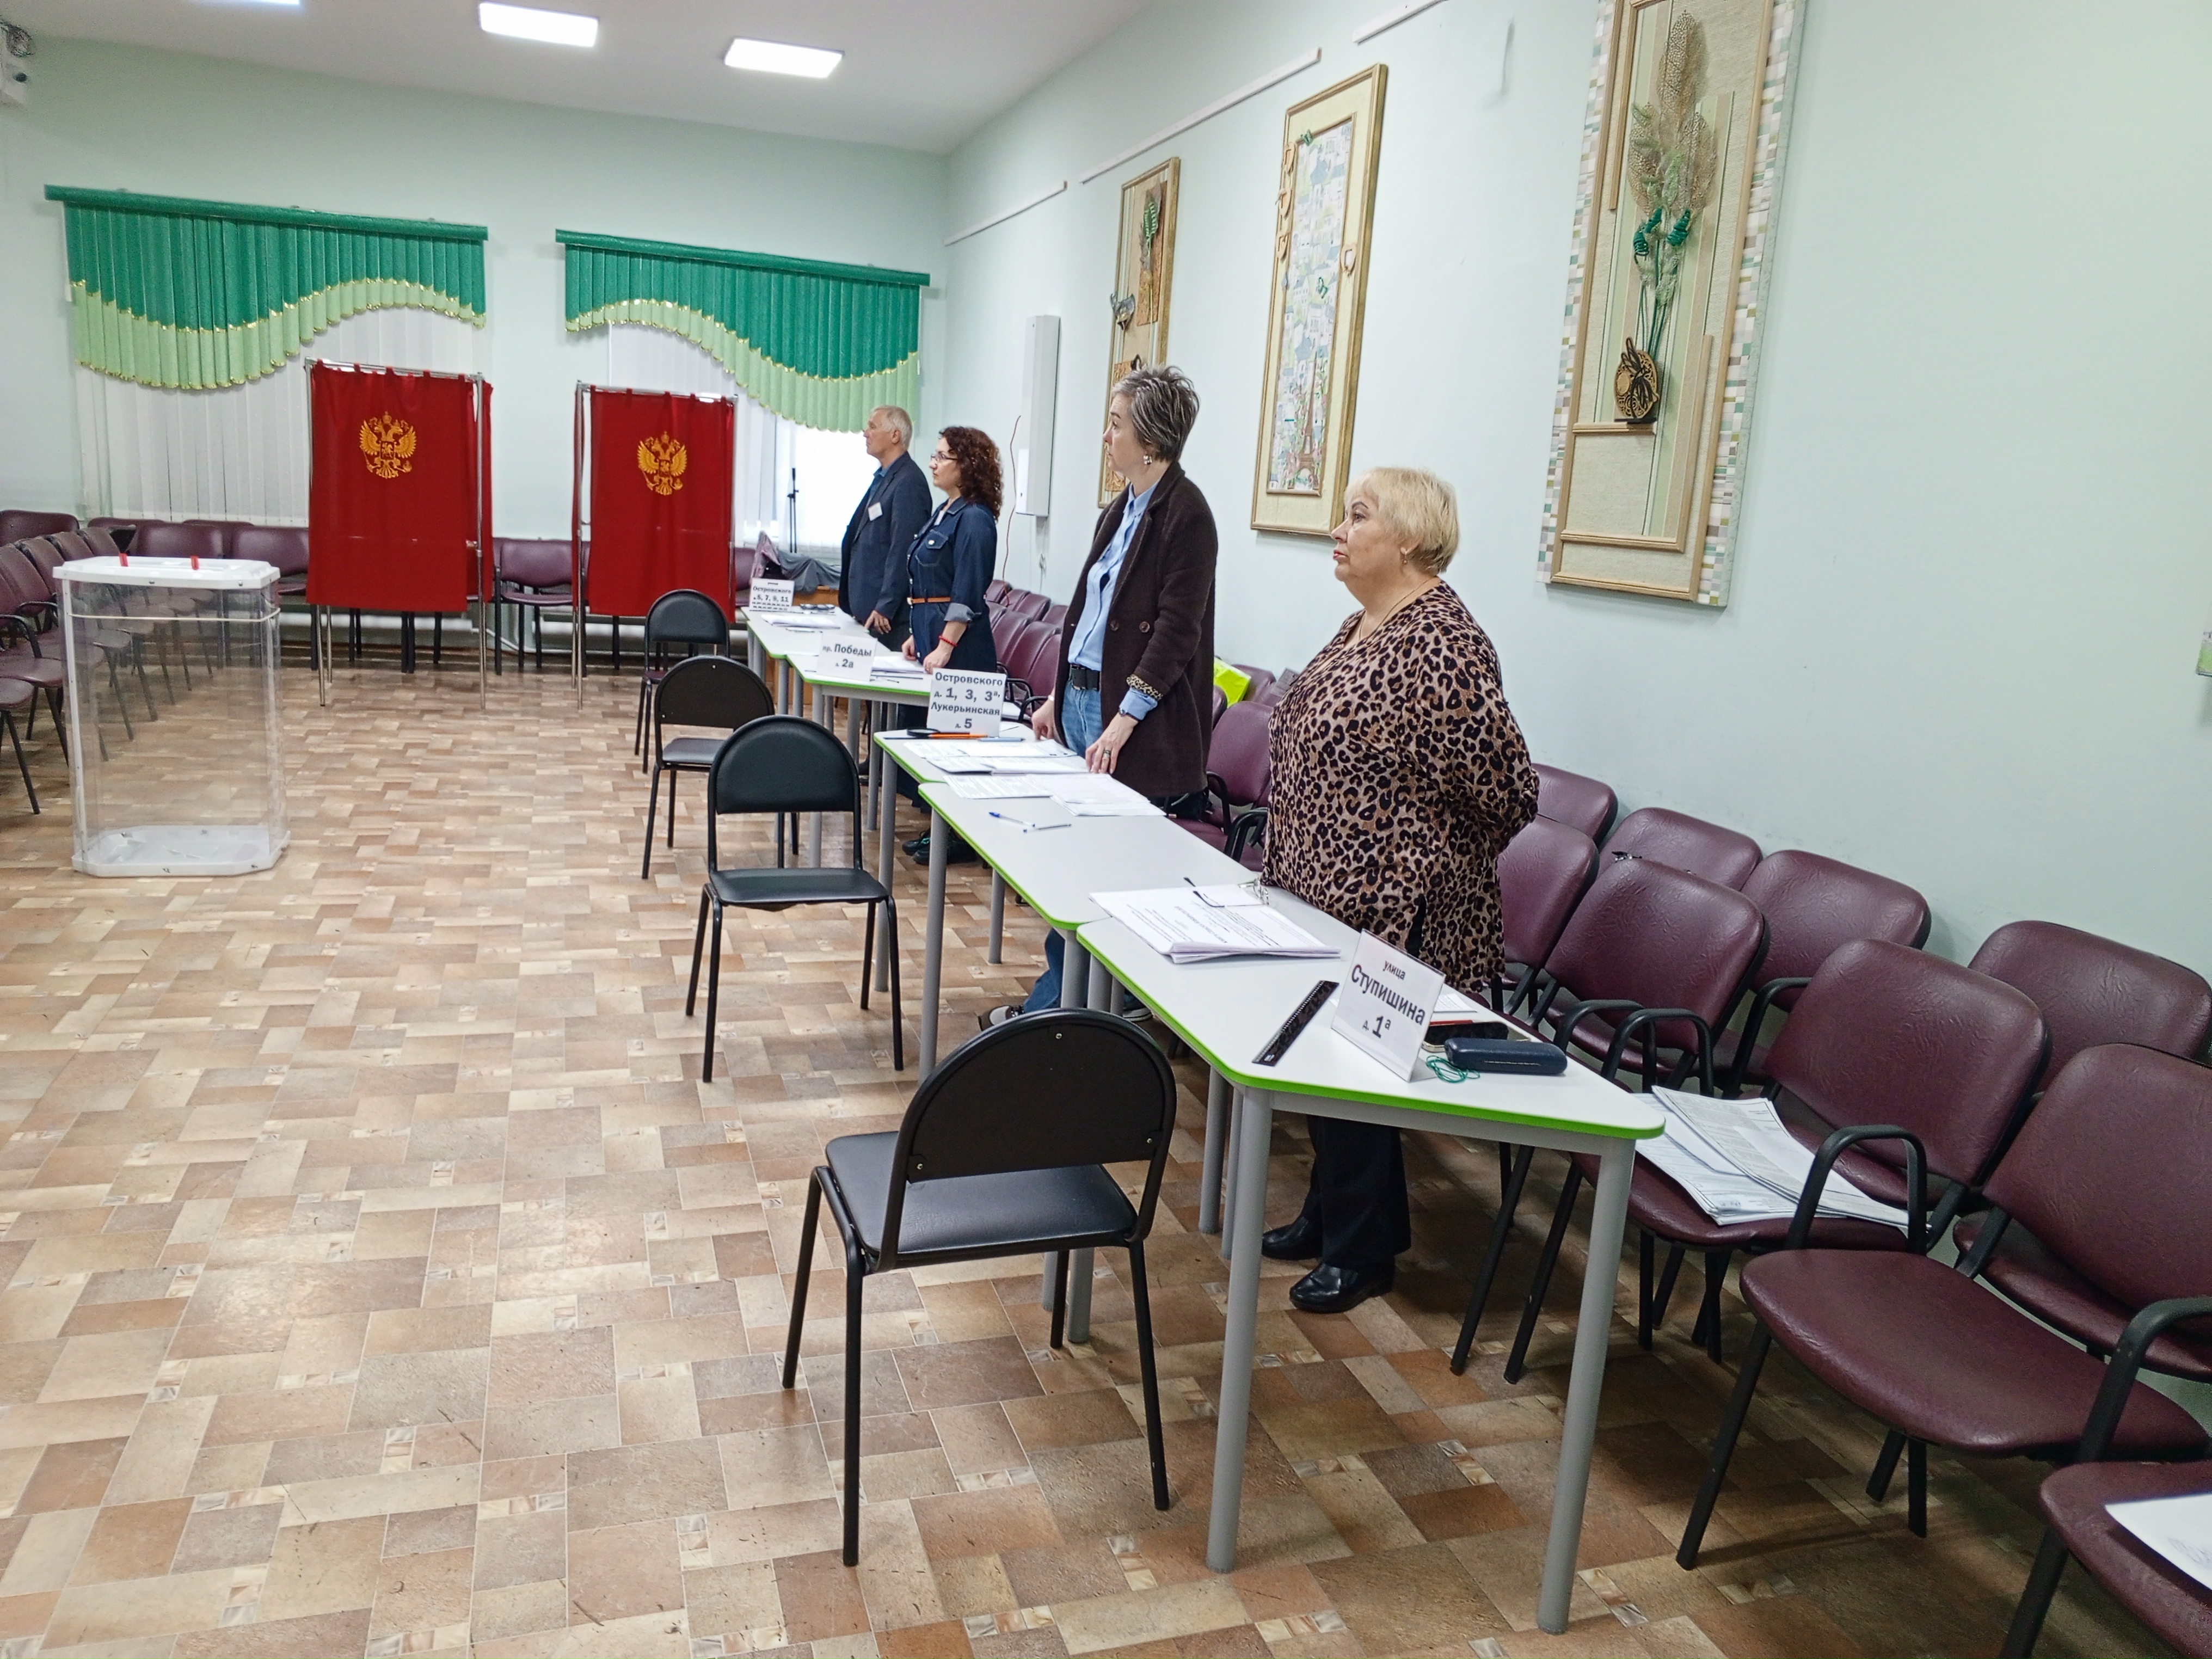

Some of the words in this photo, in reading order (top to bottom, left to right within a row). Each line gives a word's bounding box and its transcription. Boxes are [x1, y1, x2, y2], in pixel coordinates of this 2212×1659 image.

[834, 644, 872, 656] Победы
[841, 659, 854, 668] 2а
[935, 672, 1003, 686] Островского
[946, 687, 957, 701] 1,
[965, 689, 976, 702] 3,
[931, 702, 1000, 715] Лукерьинская
[964, 718, 972, 728] 5
[1382, 960, 1406, 980] улица
[1351, 964, 1425, 1025] Ступишина
